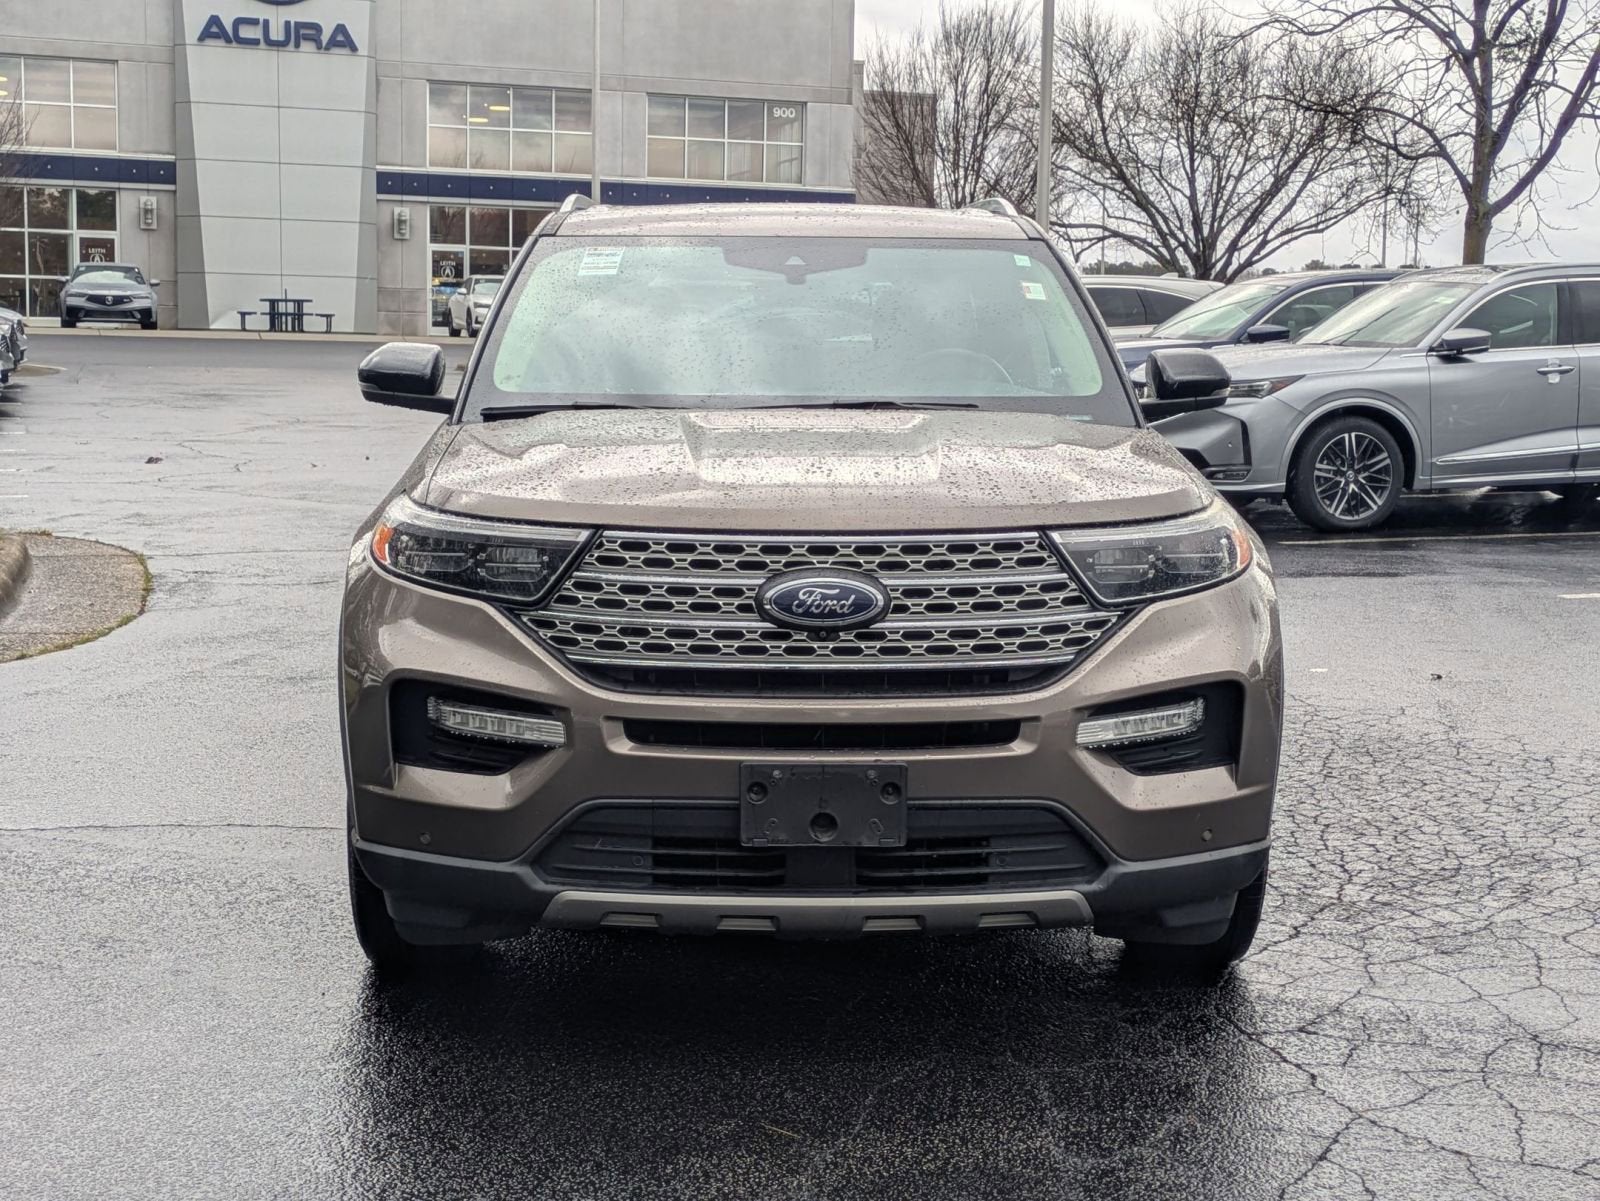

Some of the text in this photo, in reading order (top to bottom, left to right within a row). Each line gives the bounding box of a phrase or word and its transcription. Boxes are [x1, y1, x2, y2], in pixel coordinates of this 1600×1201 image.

[197, 14, 359, 52] ACURA
[773, 107, 796, 118] 900
[792, 587, 855, 614] Ford
